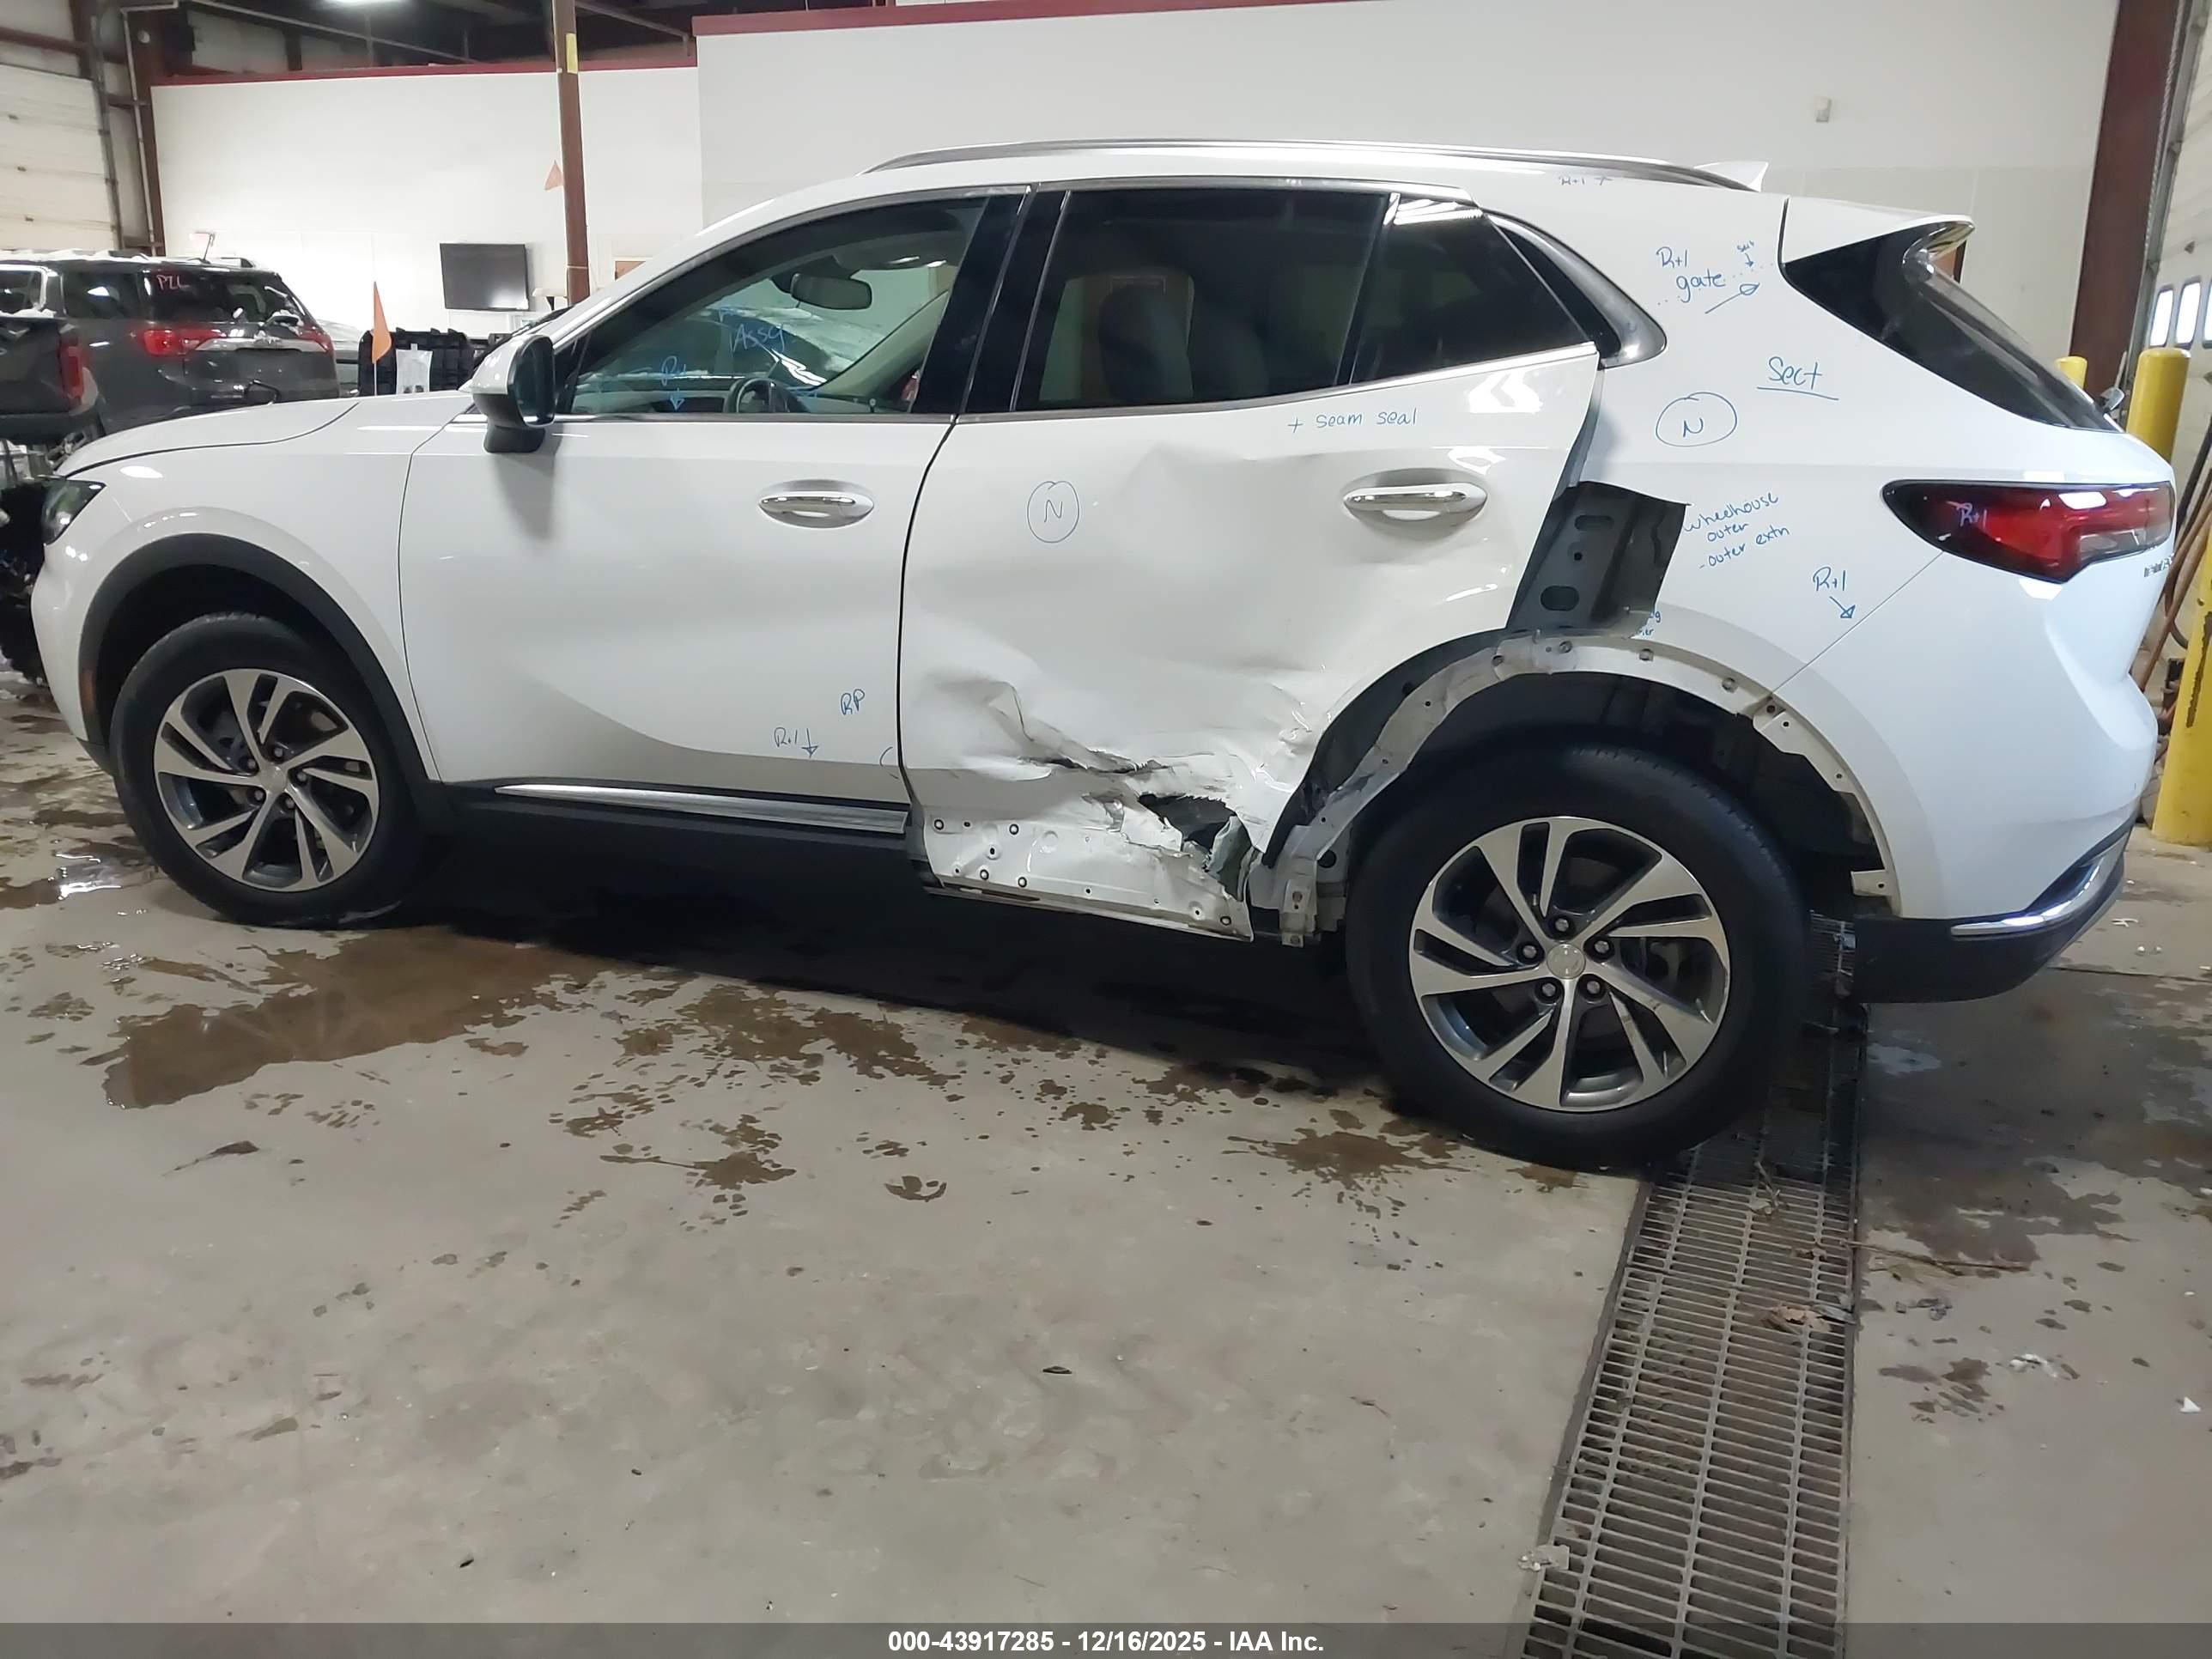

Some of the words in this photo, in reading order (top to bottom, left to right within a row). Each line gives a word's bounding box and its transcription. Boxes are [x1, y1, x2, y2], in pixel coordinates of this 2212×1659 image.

[1675, 269, 1726, 303] gate
[1316, 413, 1363, 428] seam
[1376, 407, 1417, 425] seal
[1683, 417, 1704, 437] N
[1043, 499, 1063, 523] N
[1707, 522, 1749, 542] outer
[840, 689, 866, 715] RP
